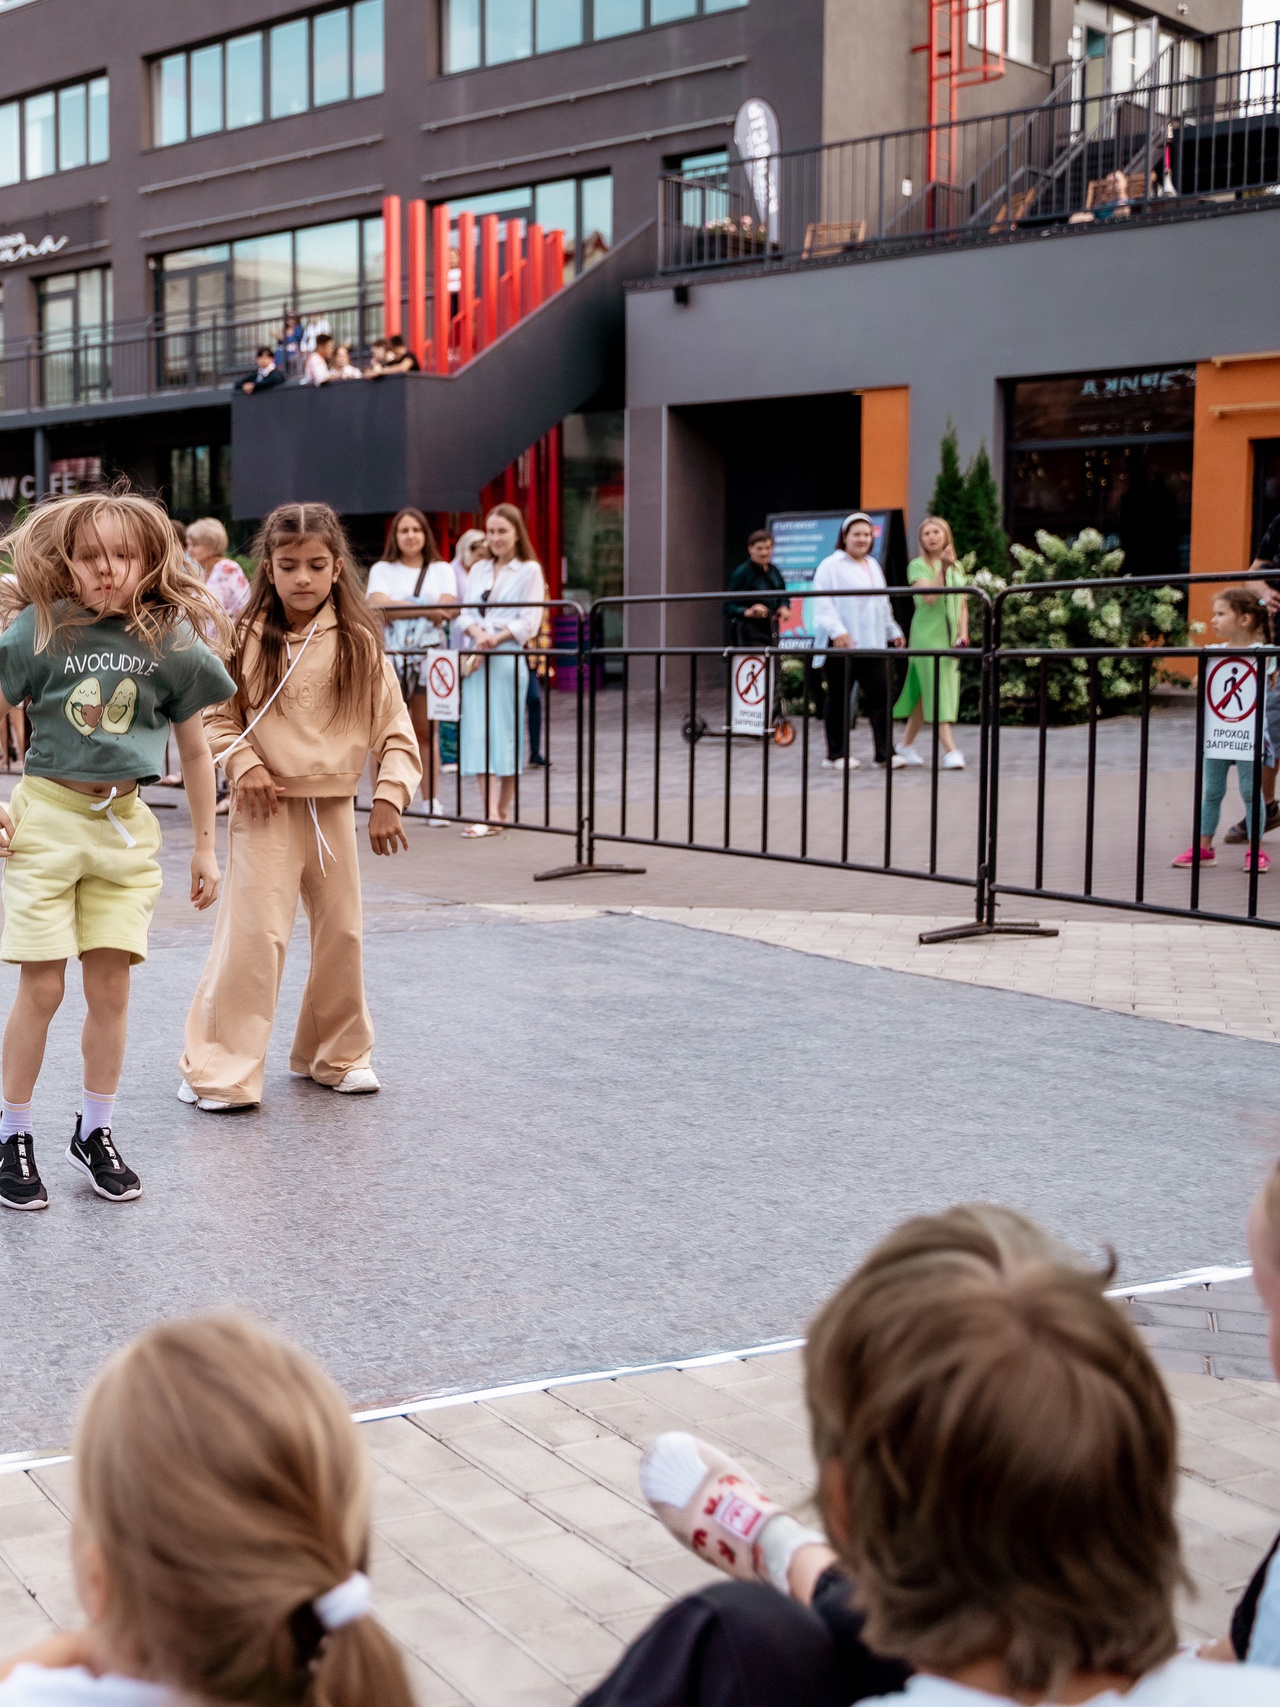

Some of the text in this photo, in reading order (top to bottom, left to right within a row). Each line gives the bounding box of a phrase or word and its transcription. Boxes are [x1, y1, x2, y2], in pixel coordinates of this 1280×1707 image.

[20, 472, 77, 499] CFE
[64, 652, 159, 676] AVOCUDDLE
[1213, 729, 1249, 740] ПРОХОД
